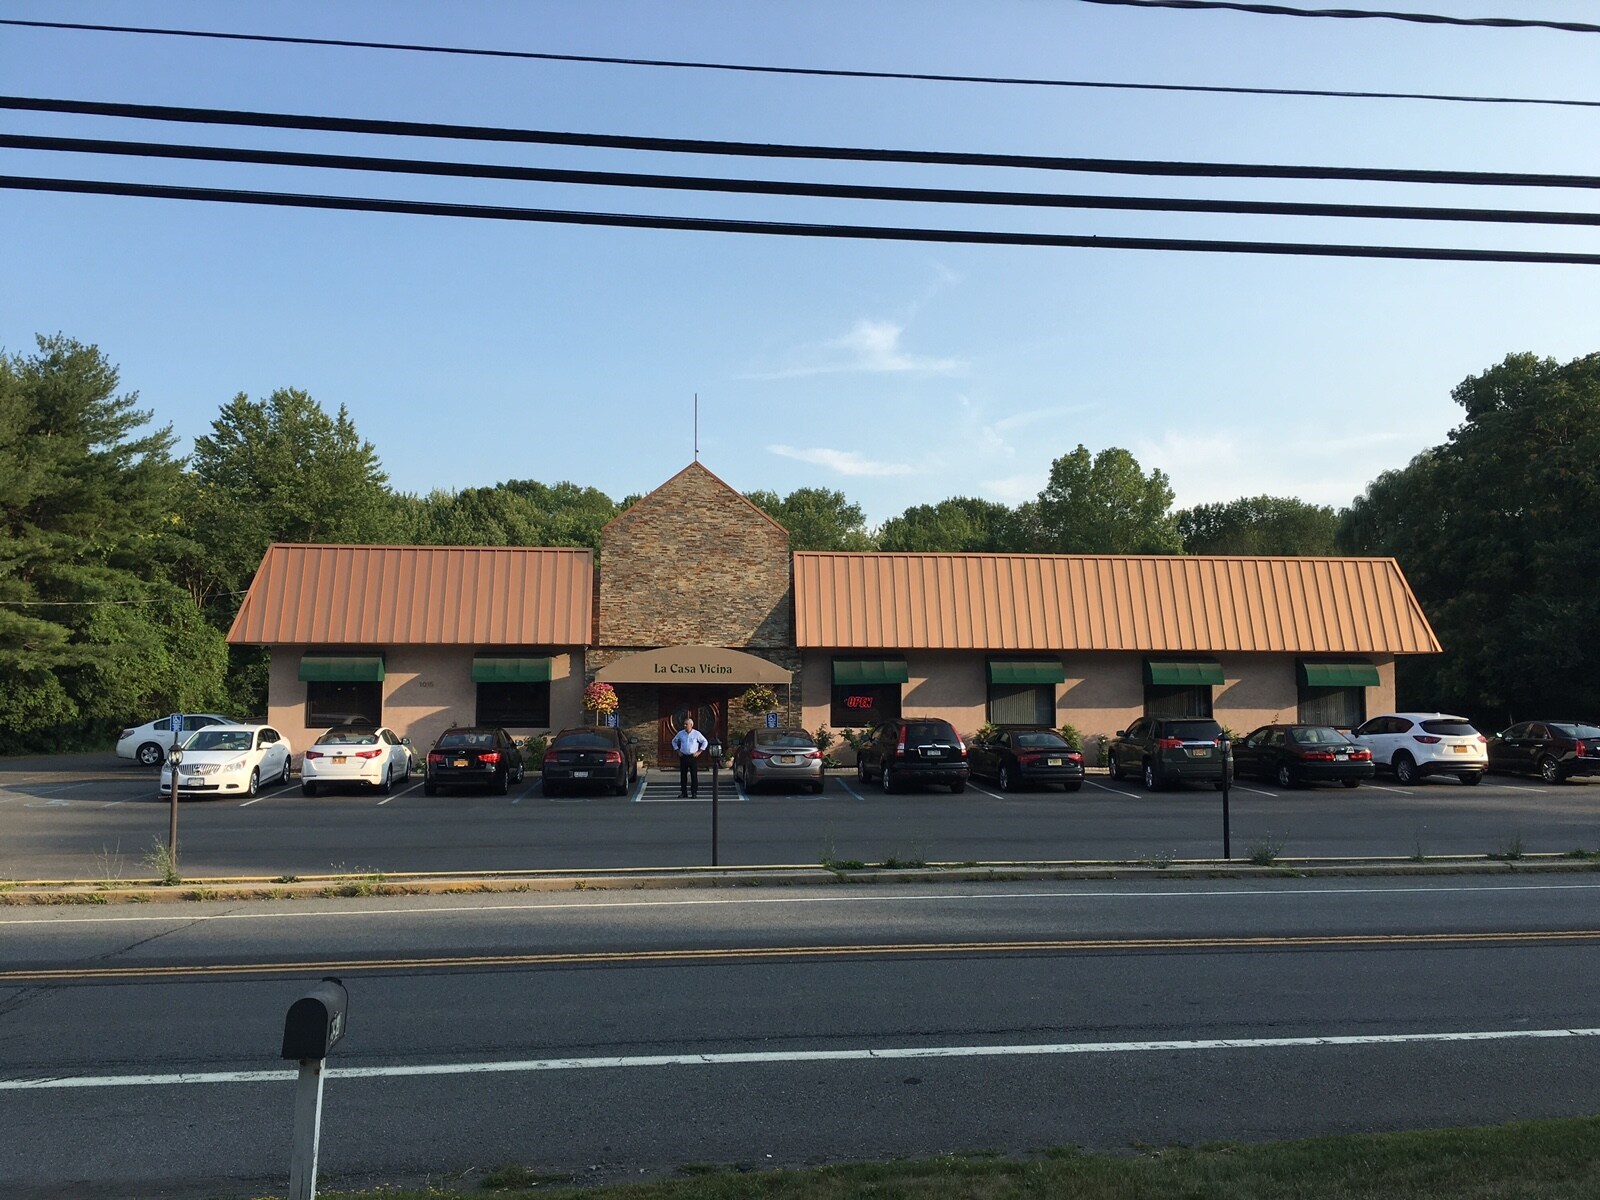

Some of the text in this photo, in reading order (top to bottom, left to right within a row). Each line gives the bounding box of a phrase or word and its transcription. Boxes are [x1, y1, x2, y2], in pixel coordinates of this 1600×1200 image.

[654, 663, 732, 674] La Casa Vicina
[847, 696, 874, 708] OPEN
